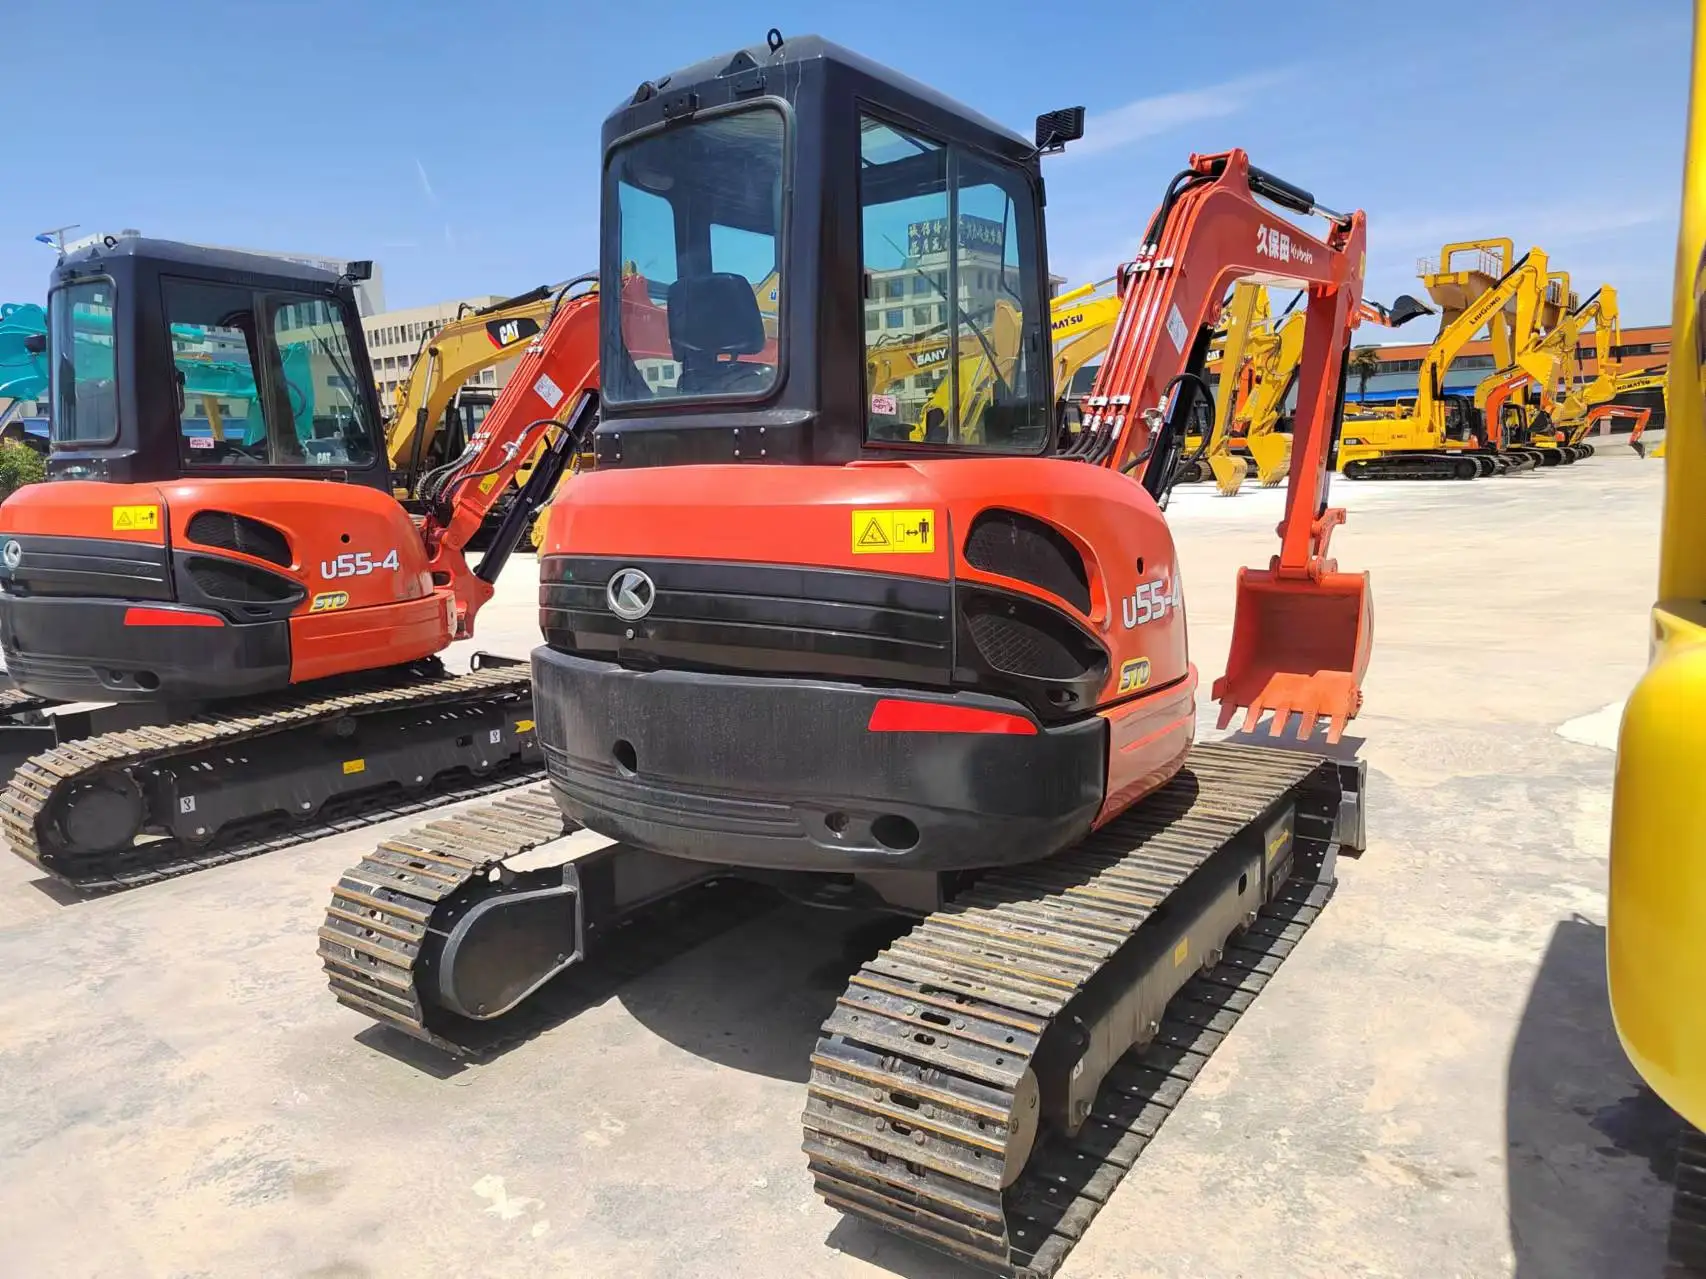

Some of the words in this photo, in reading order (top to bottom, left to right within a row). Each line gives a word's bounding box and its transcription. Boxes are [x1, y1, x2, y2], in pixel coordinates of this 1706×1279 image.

[1256, 223, 1289, 263] 久保田
[499, 319, 520, 345] CAT
[916, 348, 947, 368] SANY
